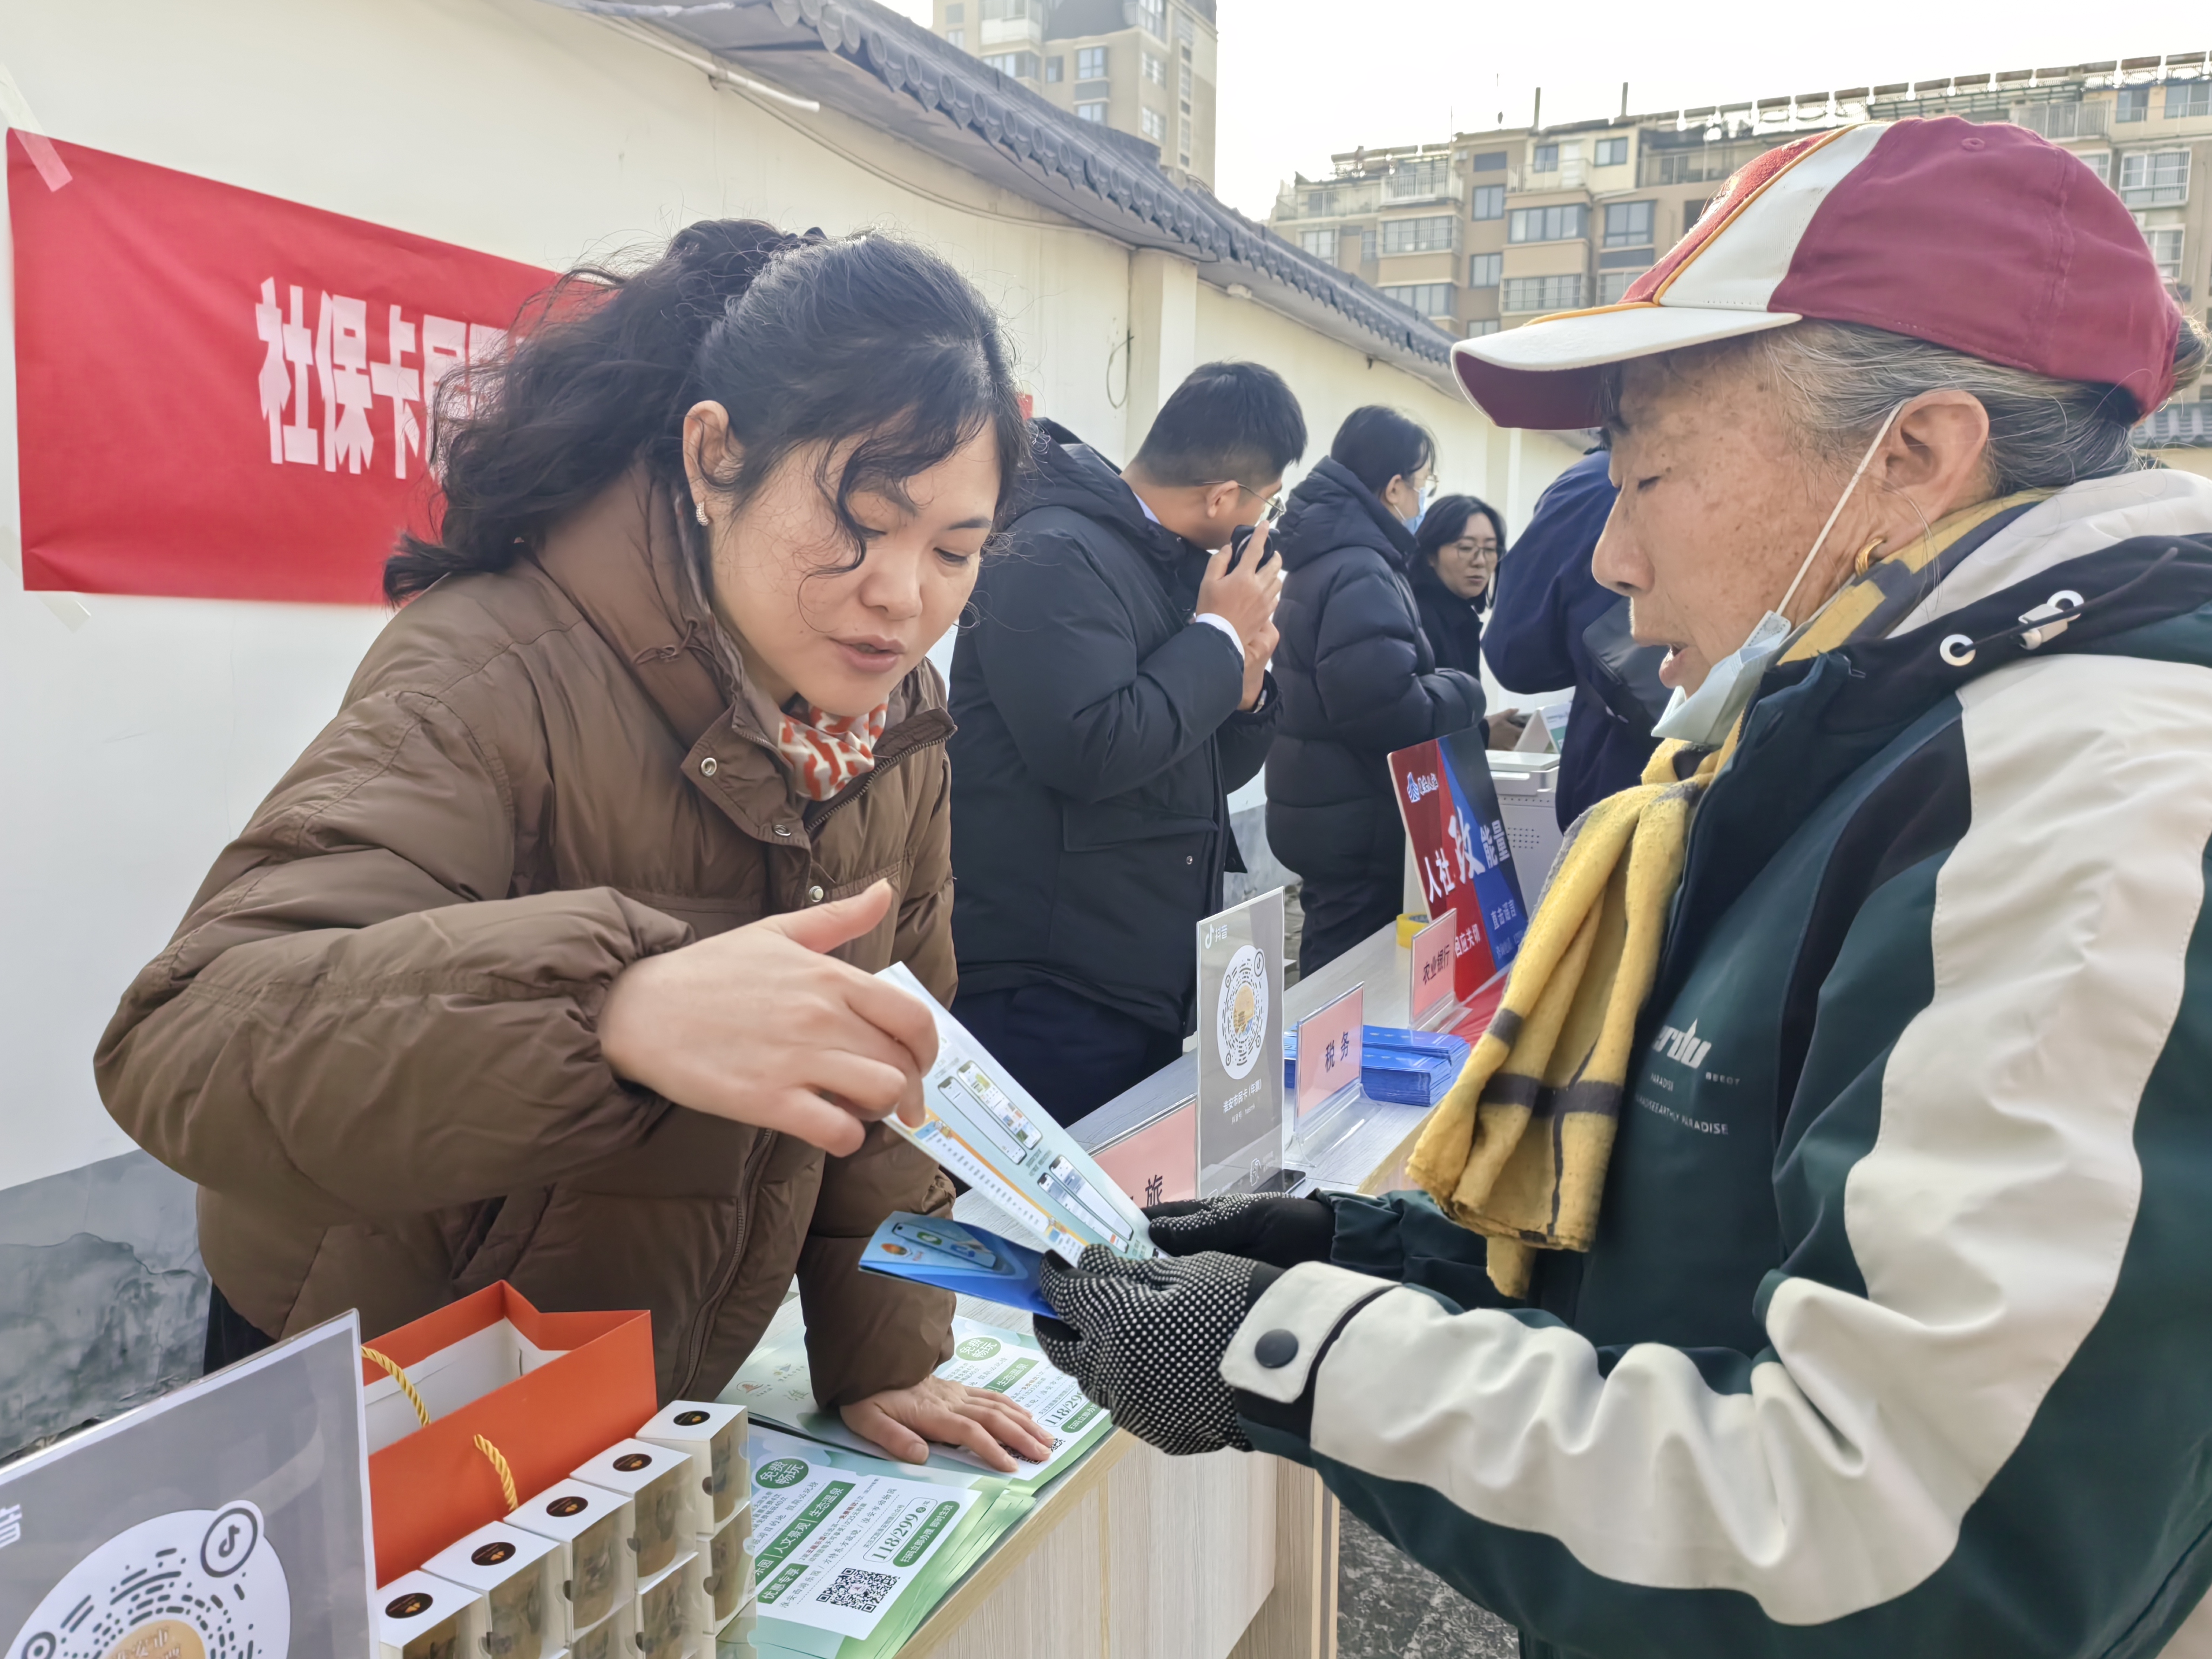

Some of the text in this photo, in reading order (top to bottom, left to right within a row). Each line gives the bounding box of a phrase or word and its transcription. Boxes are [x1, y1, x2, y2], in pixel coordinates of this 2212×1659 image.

[1425, 806, 1510, 903] 人社政能量
[1215, 924, 1228, 942] 抖音
[1455, 923, 1480, 957] 回应关切
[1422, 944, 1450, 986] 农业银行
[1325, 1031, 1350, 1073] 税务
[1682, 1115, 1729, 1135] PARADISE
[959, 1338, 984, 1354] 免费
[971, 1340, 998, 1359] 畅玩
[995, 1362, 1029, 1386] 生态温泉
[757, 1460, 788, 1481] 免费
[773, 1463, 805, 1486] 畅玩
[771, 1521, 812, 1554] 人文景观
[807, 1486, 845, 1518] 生态温泉
[868, 1512, 922, 1561] 118/299
[898, 1503, 955, 1563] 扫码立即办理 即时生效
[760, 1566, 802, 1600] 优惠专享
